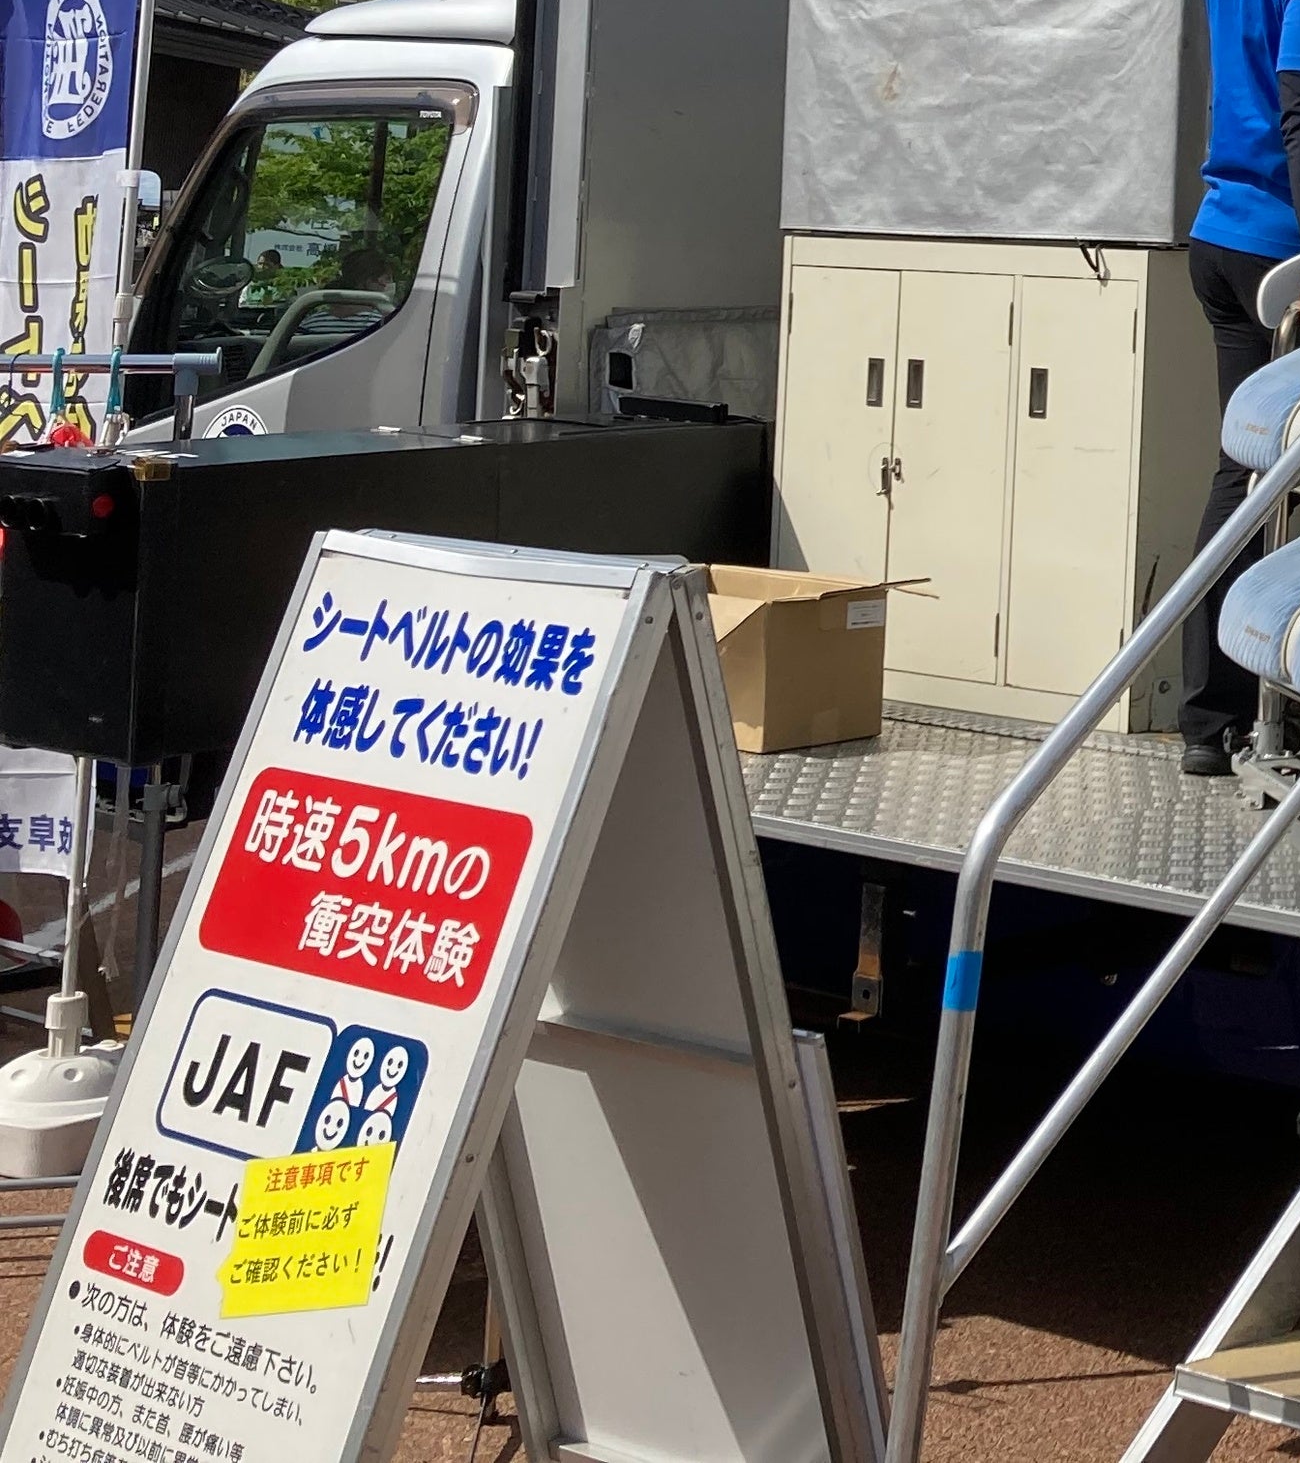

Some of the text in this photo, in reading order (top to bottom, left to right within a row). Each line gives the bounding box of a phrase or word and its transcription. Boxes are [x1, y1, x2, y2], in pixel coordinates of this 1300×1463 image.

[221, 411, 258, 431] JAPAN
[302, 591, 596, 696] シートベルトの効果を
[245, 787, 491, 903] 時速5kmの
[298, 891, 481, 990] 衝突体験
[181, 1032, 312, 1130] JAF
[264, 1156, 370, 1194] 注意事項です
[238, 1201, 360, 1239] ご体験前に必ず
[107, 1242, 160, 1283] ご注意
[71, 1348, 206, 1419] 適切な装着が出来ない方
